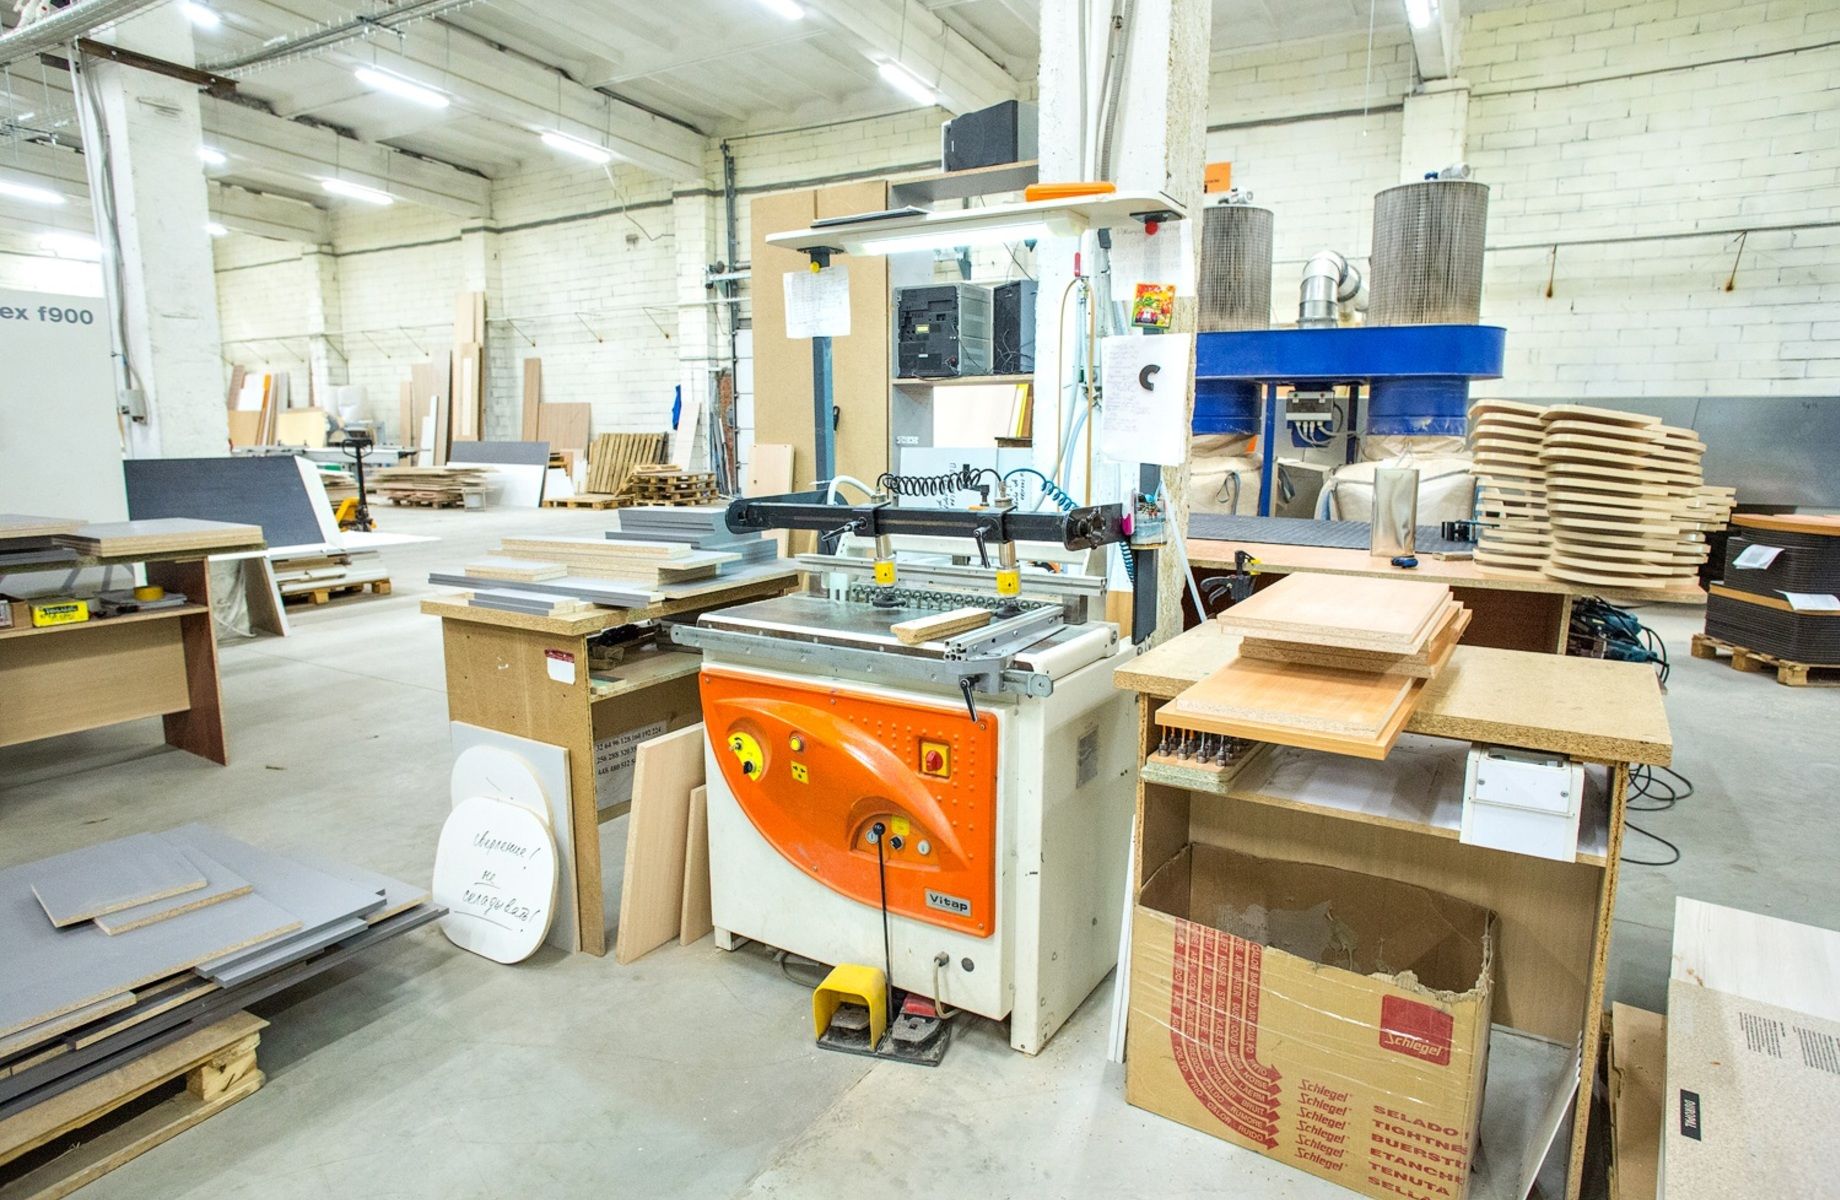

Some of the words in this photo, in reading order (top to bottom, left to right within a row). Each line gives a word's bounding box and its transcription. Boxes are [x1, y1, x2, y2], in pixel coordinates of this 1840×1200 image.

[0, 306, 29, 321] ex
[37, 305, 94, 326] f900
[929, 893, 968, 912] Vitap
[1384, 1030, 1442, 1057] Schlegel
[1208, 1065, 1237, 1098] CHALEUR
[1241, 1099, 1266, 1116] BRUIT
[1298, 1079, 1348, 1102] Schlegel
[1297, 1092, 1347, 1116] Schlegel
[1206, 1101, 1232, 1125] CALOR
[1238, 1124, 1264, 1141] RUIDO
[1229, 1105, 1264, 1128] RUMORE
[1296, 1106, 1346, 1130] Schlegel
[1373, 1104, 1459, 1137] SELADO
[1296, 1120, 1345, 1144] Schlegel
[1295, 1134, 1345, 1158] Schlegel
[1294, 1147, 1344, 1171] Schlegel
[1367, 1160, 1450, 1196] TENUTA
